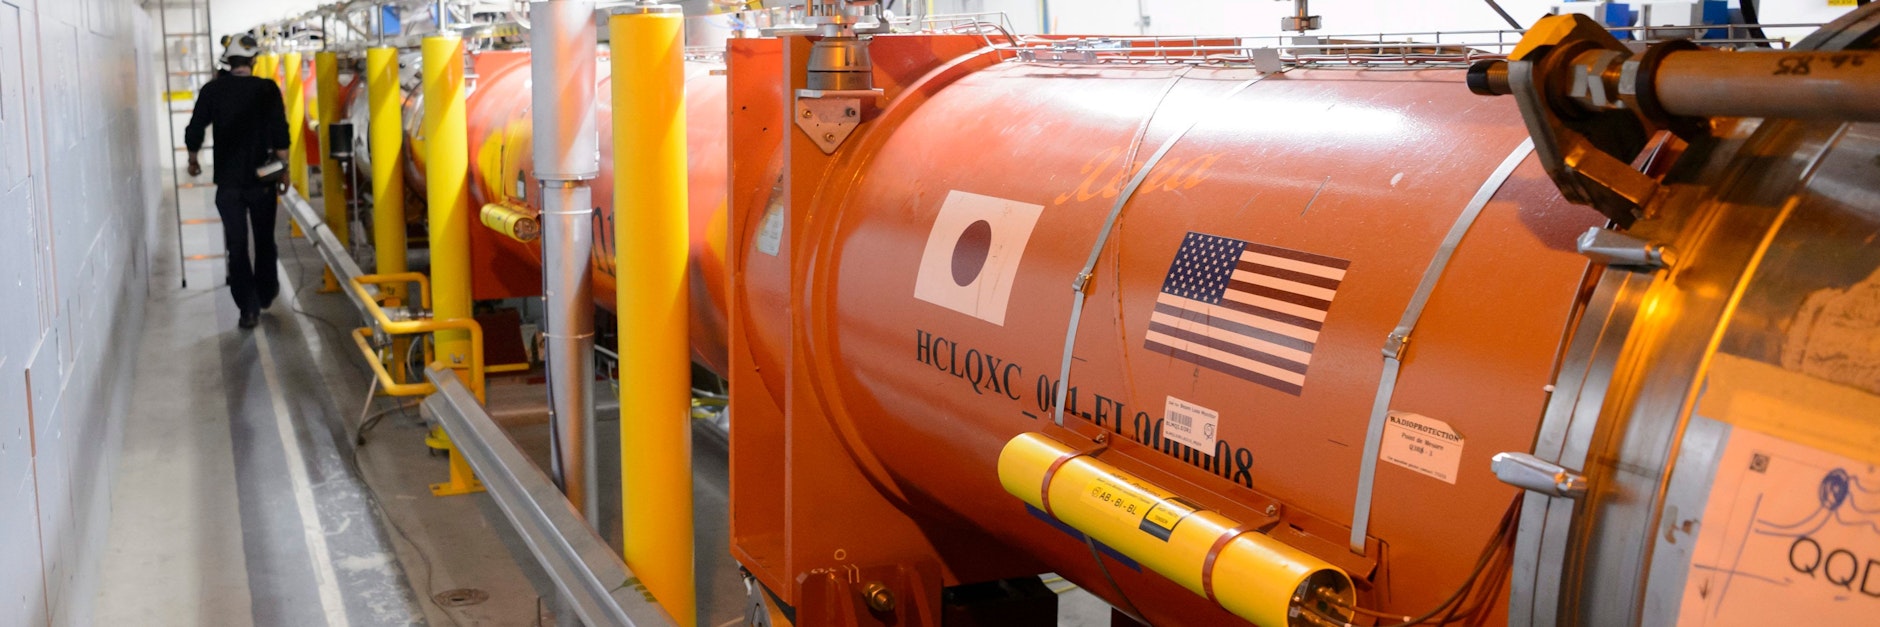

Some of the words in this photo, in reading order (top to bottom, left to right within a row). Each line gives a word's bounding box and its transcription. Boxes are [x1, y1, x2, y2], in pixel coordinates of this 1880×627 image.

[1390, 415, 1460, 442] RADIOPROTECTION
[1401, 432, 1415, 442] Point
[1424, 439, 1444, 450] Mesure
[1099, 491, 1112, 503] AB
[1126, 503, 1136, 515] BL
